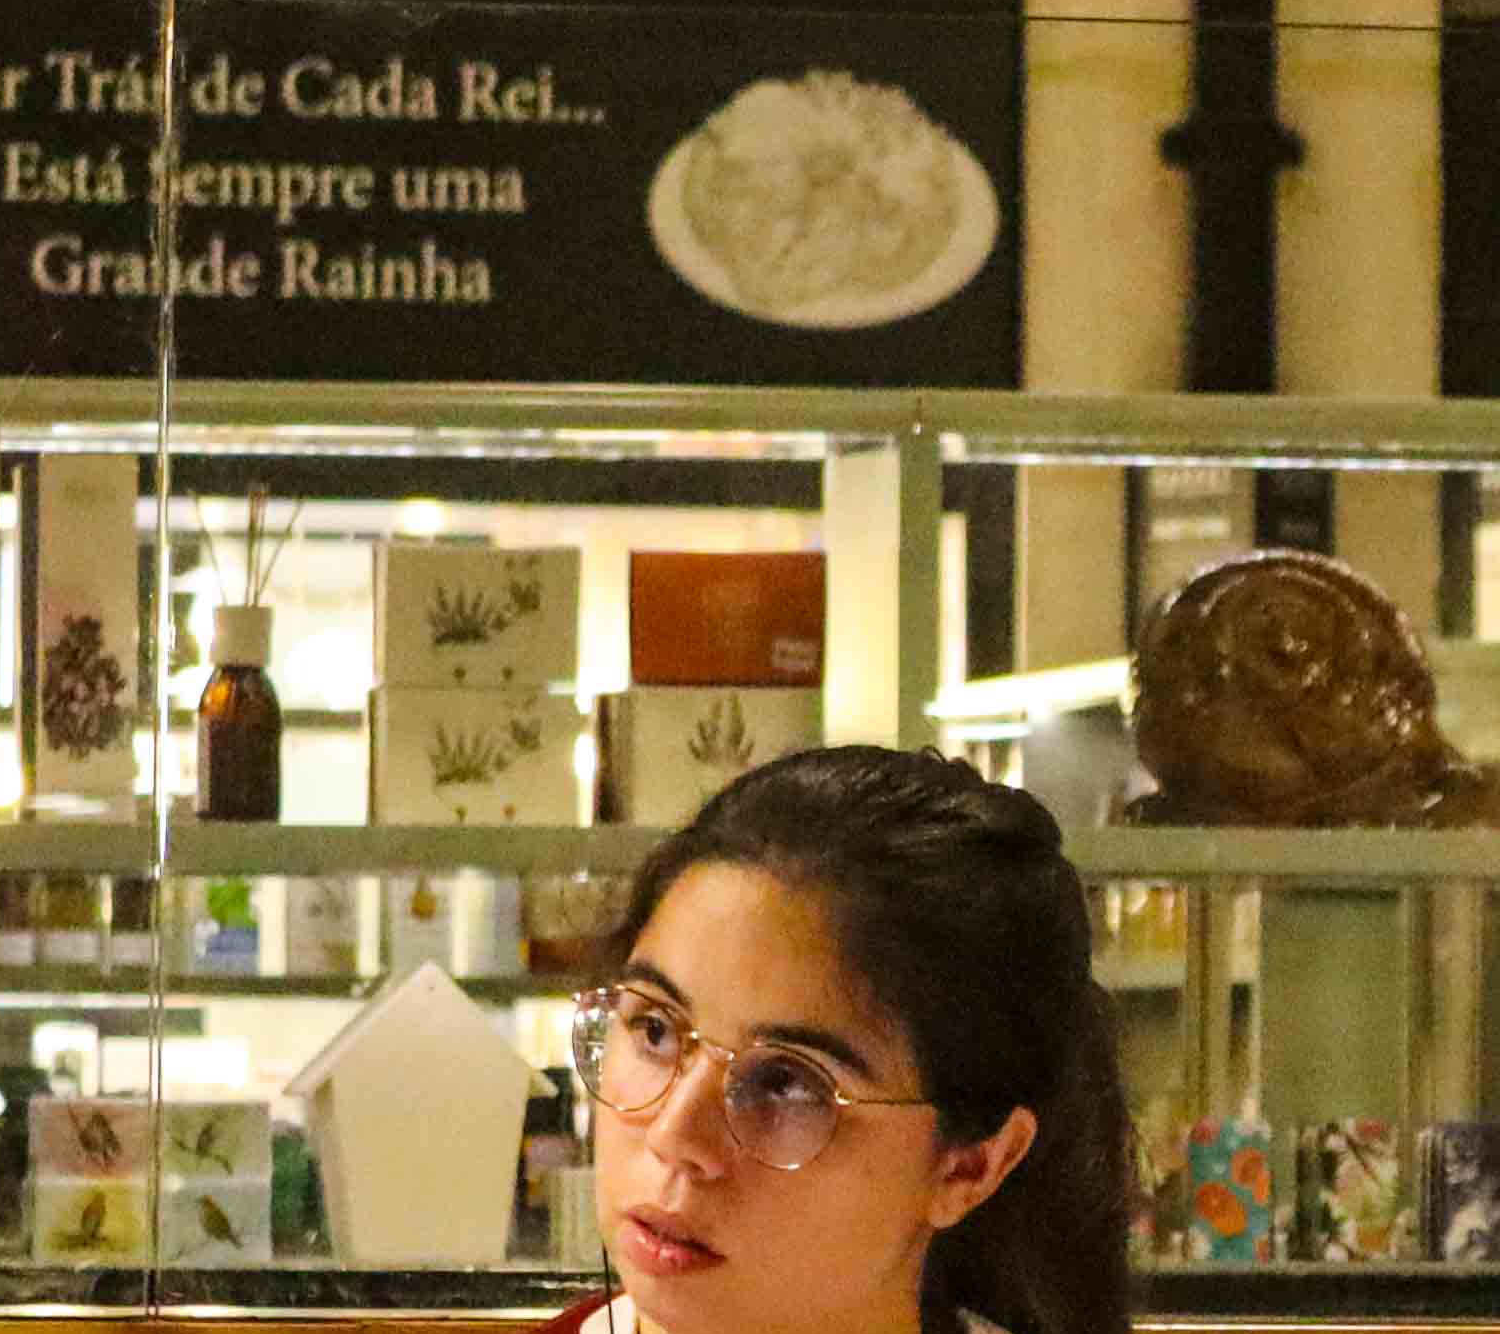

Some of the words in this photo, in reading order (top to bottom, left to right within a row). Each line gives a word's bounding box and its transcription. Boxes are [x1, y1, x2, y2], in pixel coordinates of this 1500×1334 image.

[188, 53, 265, 116] de
[281, 59, 438, 120] Cada
[2, 142, 127, 203] Está
[390, 165, 526, 213] uma
[280, 237, 492, 302] Rainha
